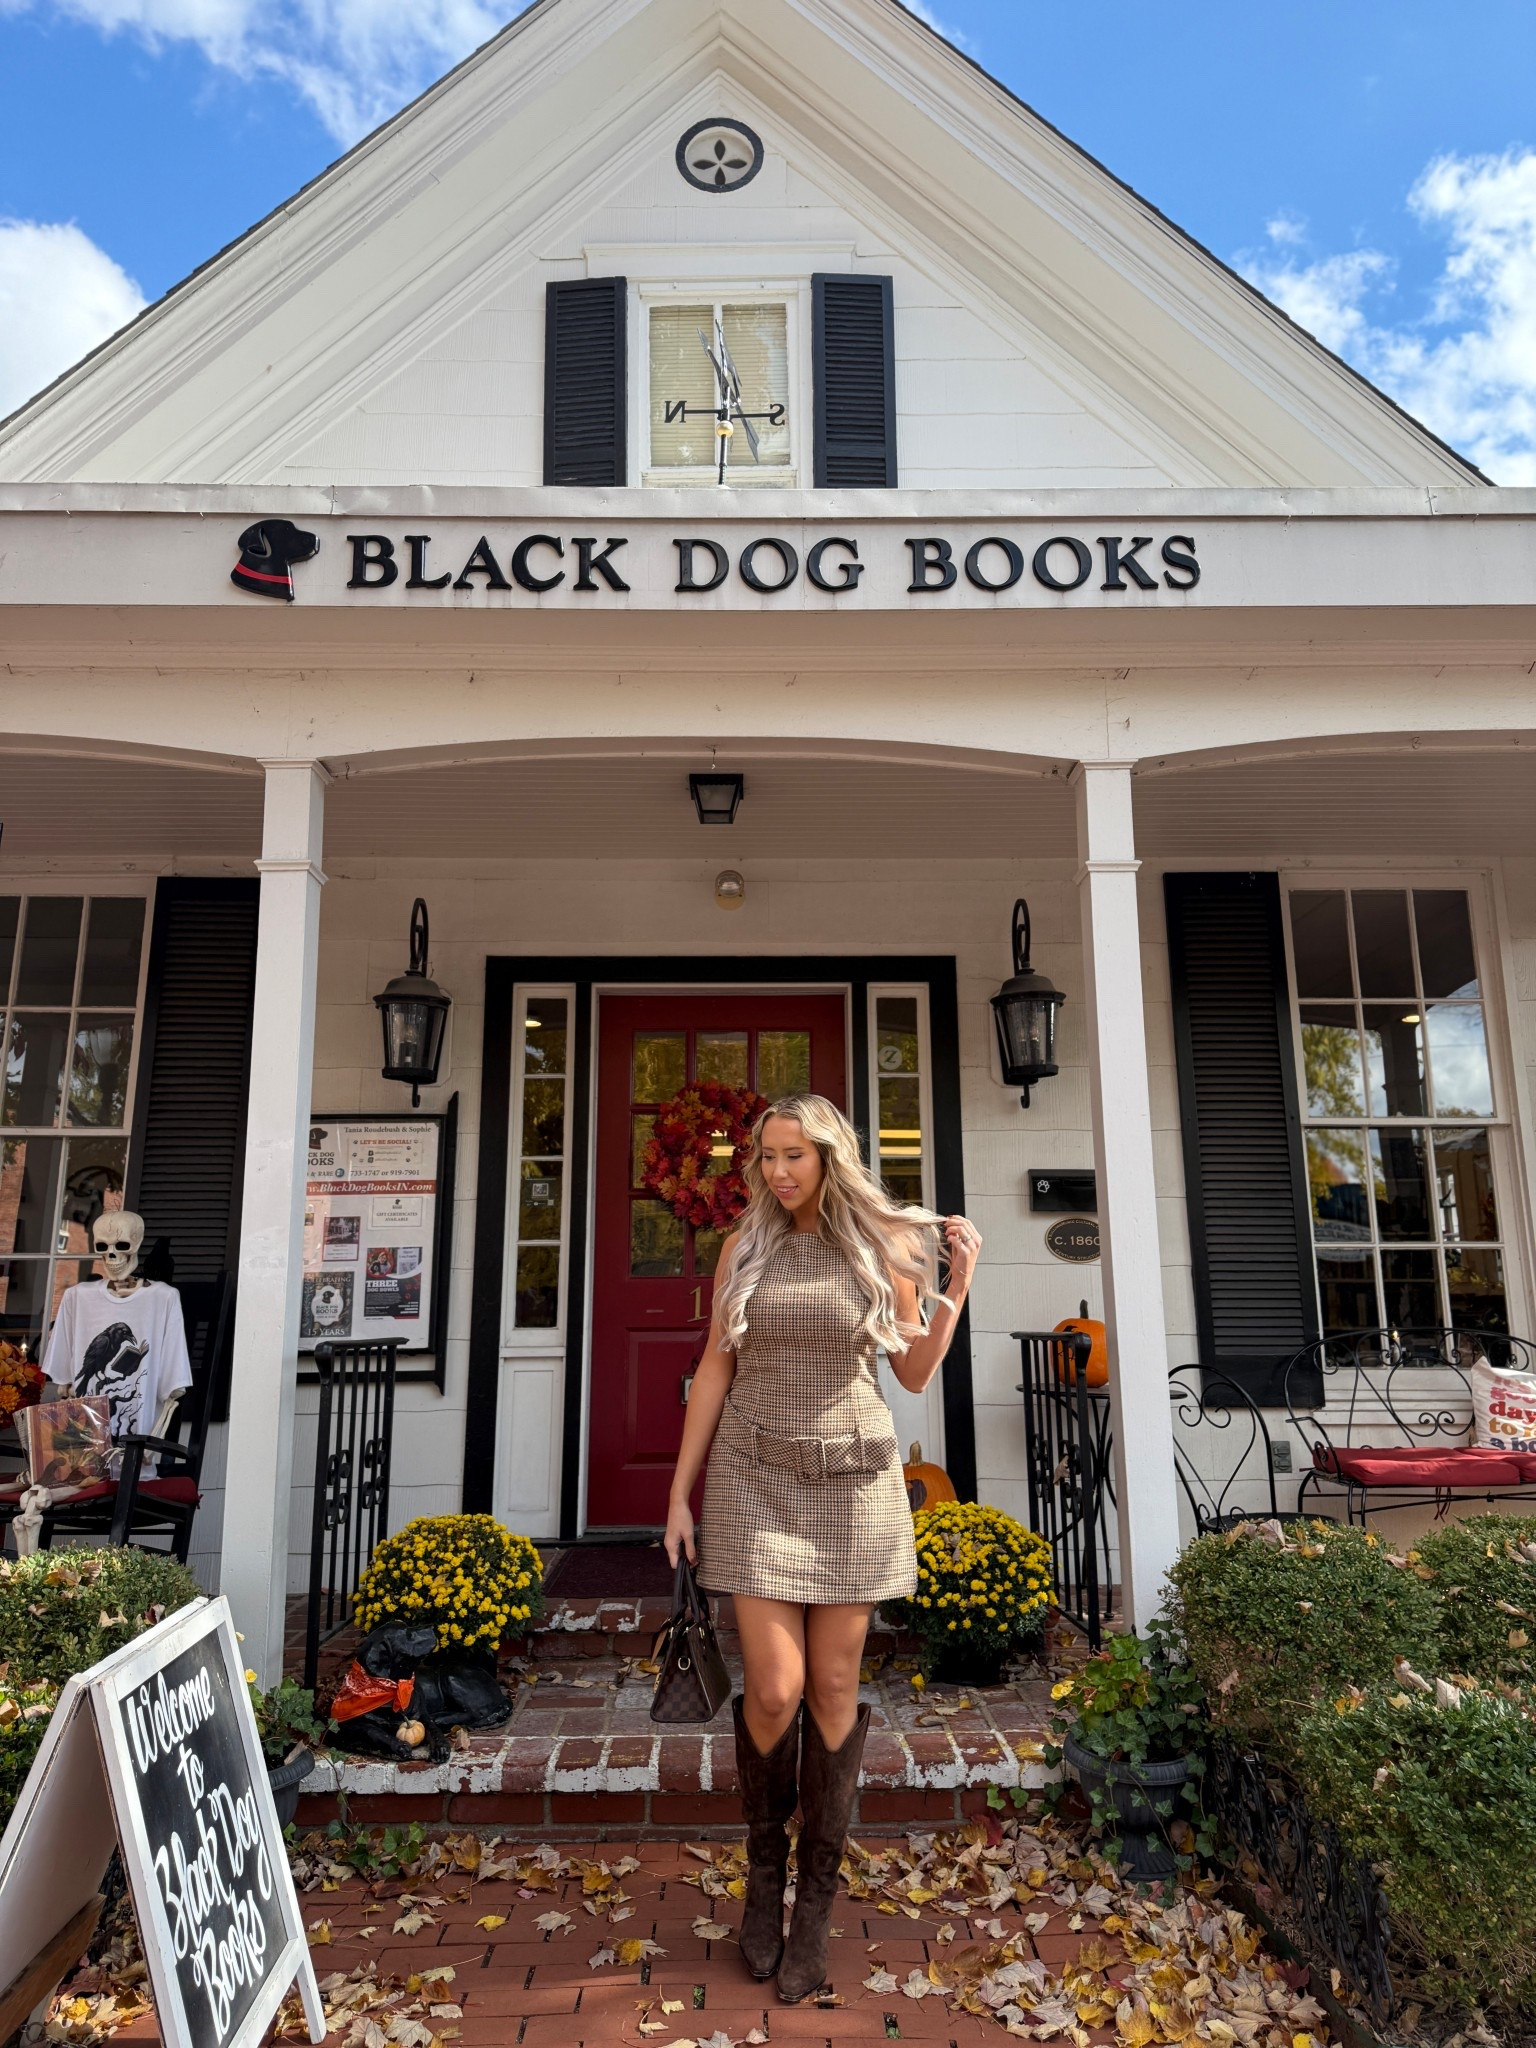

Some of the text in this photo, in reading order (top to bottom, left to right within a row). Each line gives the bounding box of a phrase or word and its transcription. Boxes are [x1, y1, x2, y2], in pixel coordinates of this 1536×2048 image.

[346, 533, 1202, 594] BLACK DOG BOOKS
[409, 1126, 431, 1134] Sophie
[1054, 1236, 1067, 1246] C.
[366, 1280, 398, 1288] THREE
[687, 1285, 708, 1322] 1
[308, 1328, 345, 1336] 15 YEARS
[1489, 1401, 1536, 1425] day
[1489, 1417, 1518, 1436] to
[126, 1666, 215, 1774] Welcome
[177, 1743, 205, 1808] to
[154, 1782, 272, 1966] Black Dog
[192, 1889, 267, 2046] Books
